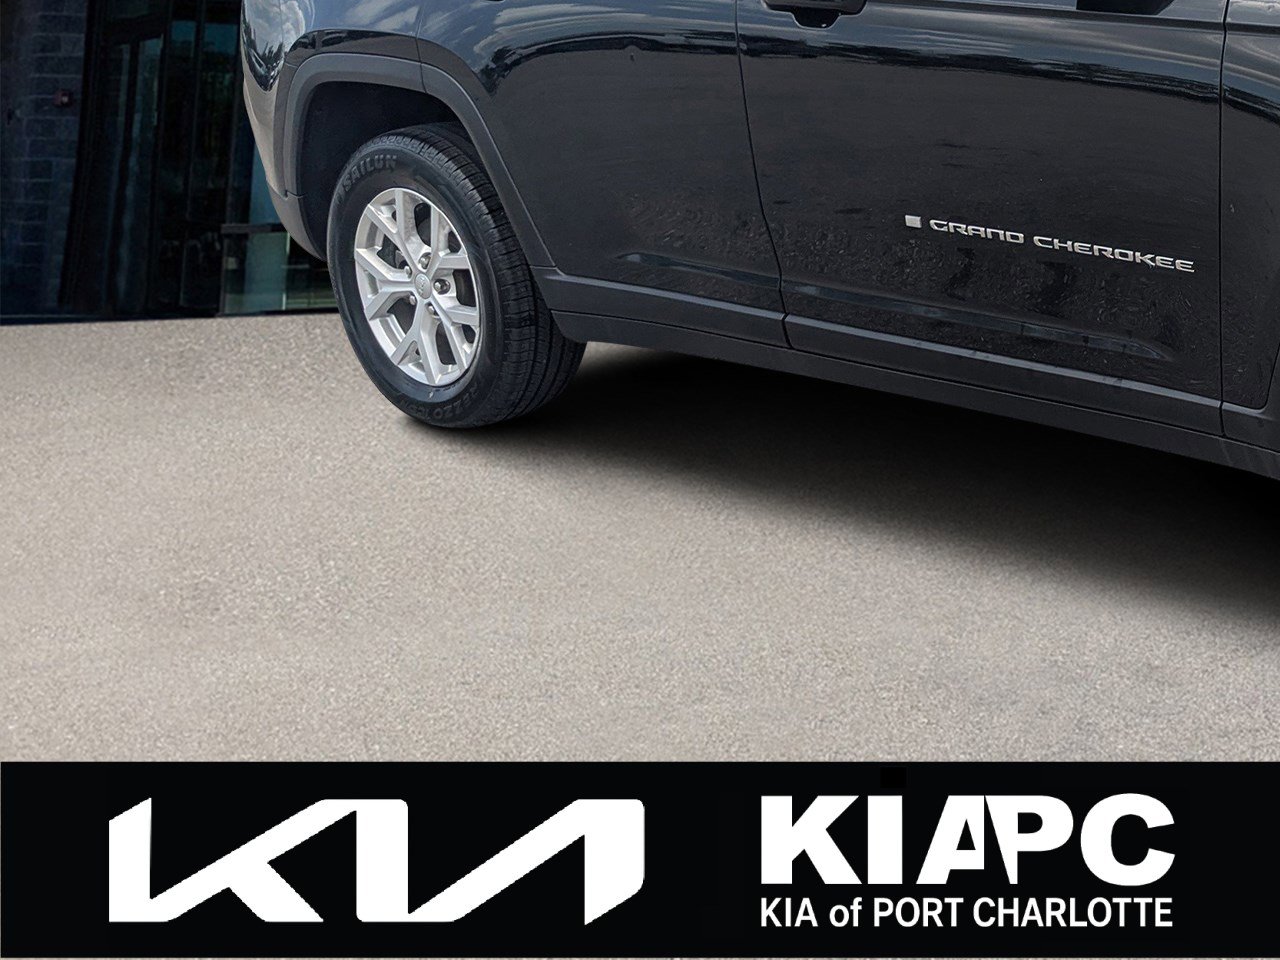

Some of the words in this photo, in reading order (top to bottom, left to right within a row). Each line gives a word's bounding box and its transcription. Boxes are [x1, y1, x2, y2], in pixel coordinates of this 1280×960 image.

[342, 153, 398, 192] SAILUN
[929, 219, 1025, 244] GRAND
[1033, 235, 1195, 273] CHEROKEE
